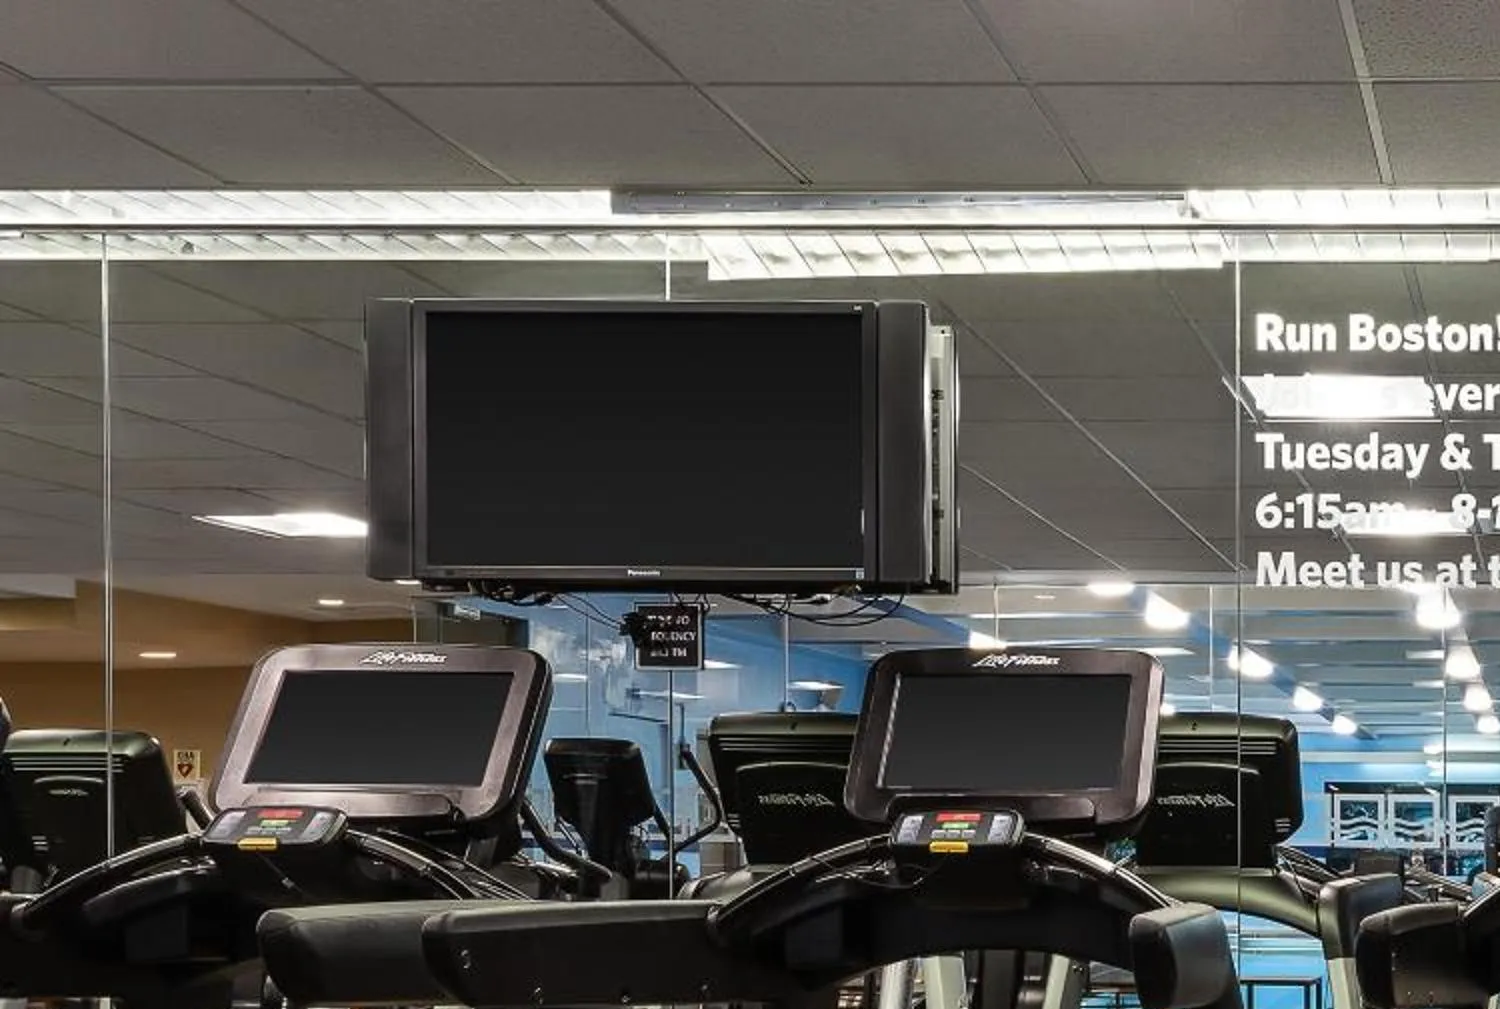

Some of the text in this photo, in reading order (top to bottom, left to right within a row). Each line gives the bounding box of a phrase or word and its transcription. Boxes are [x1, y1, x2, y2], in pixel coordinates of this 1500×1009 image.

[1256, 314, 1336, 352] Run
[1256, 432, 1429, 478] Tuesday
[1440, 434, 1472, 471] &
[1256, 551, 1365, 589] Meet
[1377, 562, 1422, 589] us
[1436, 556, 1478, 589] at
